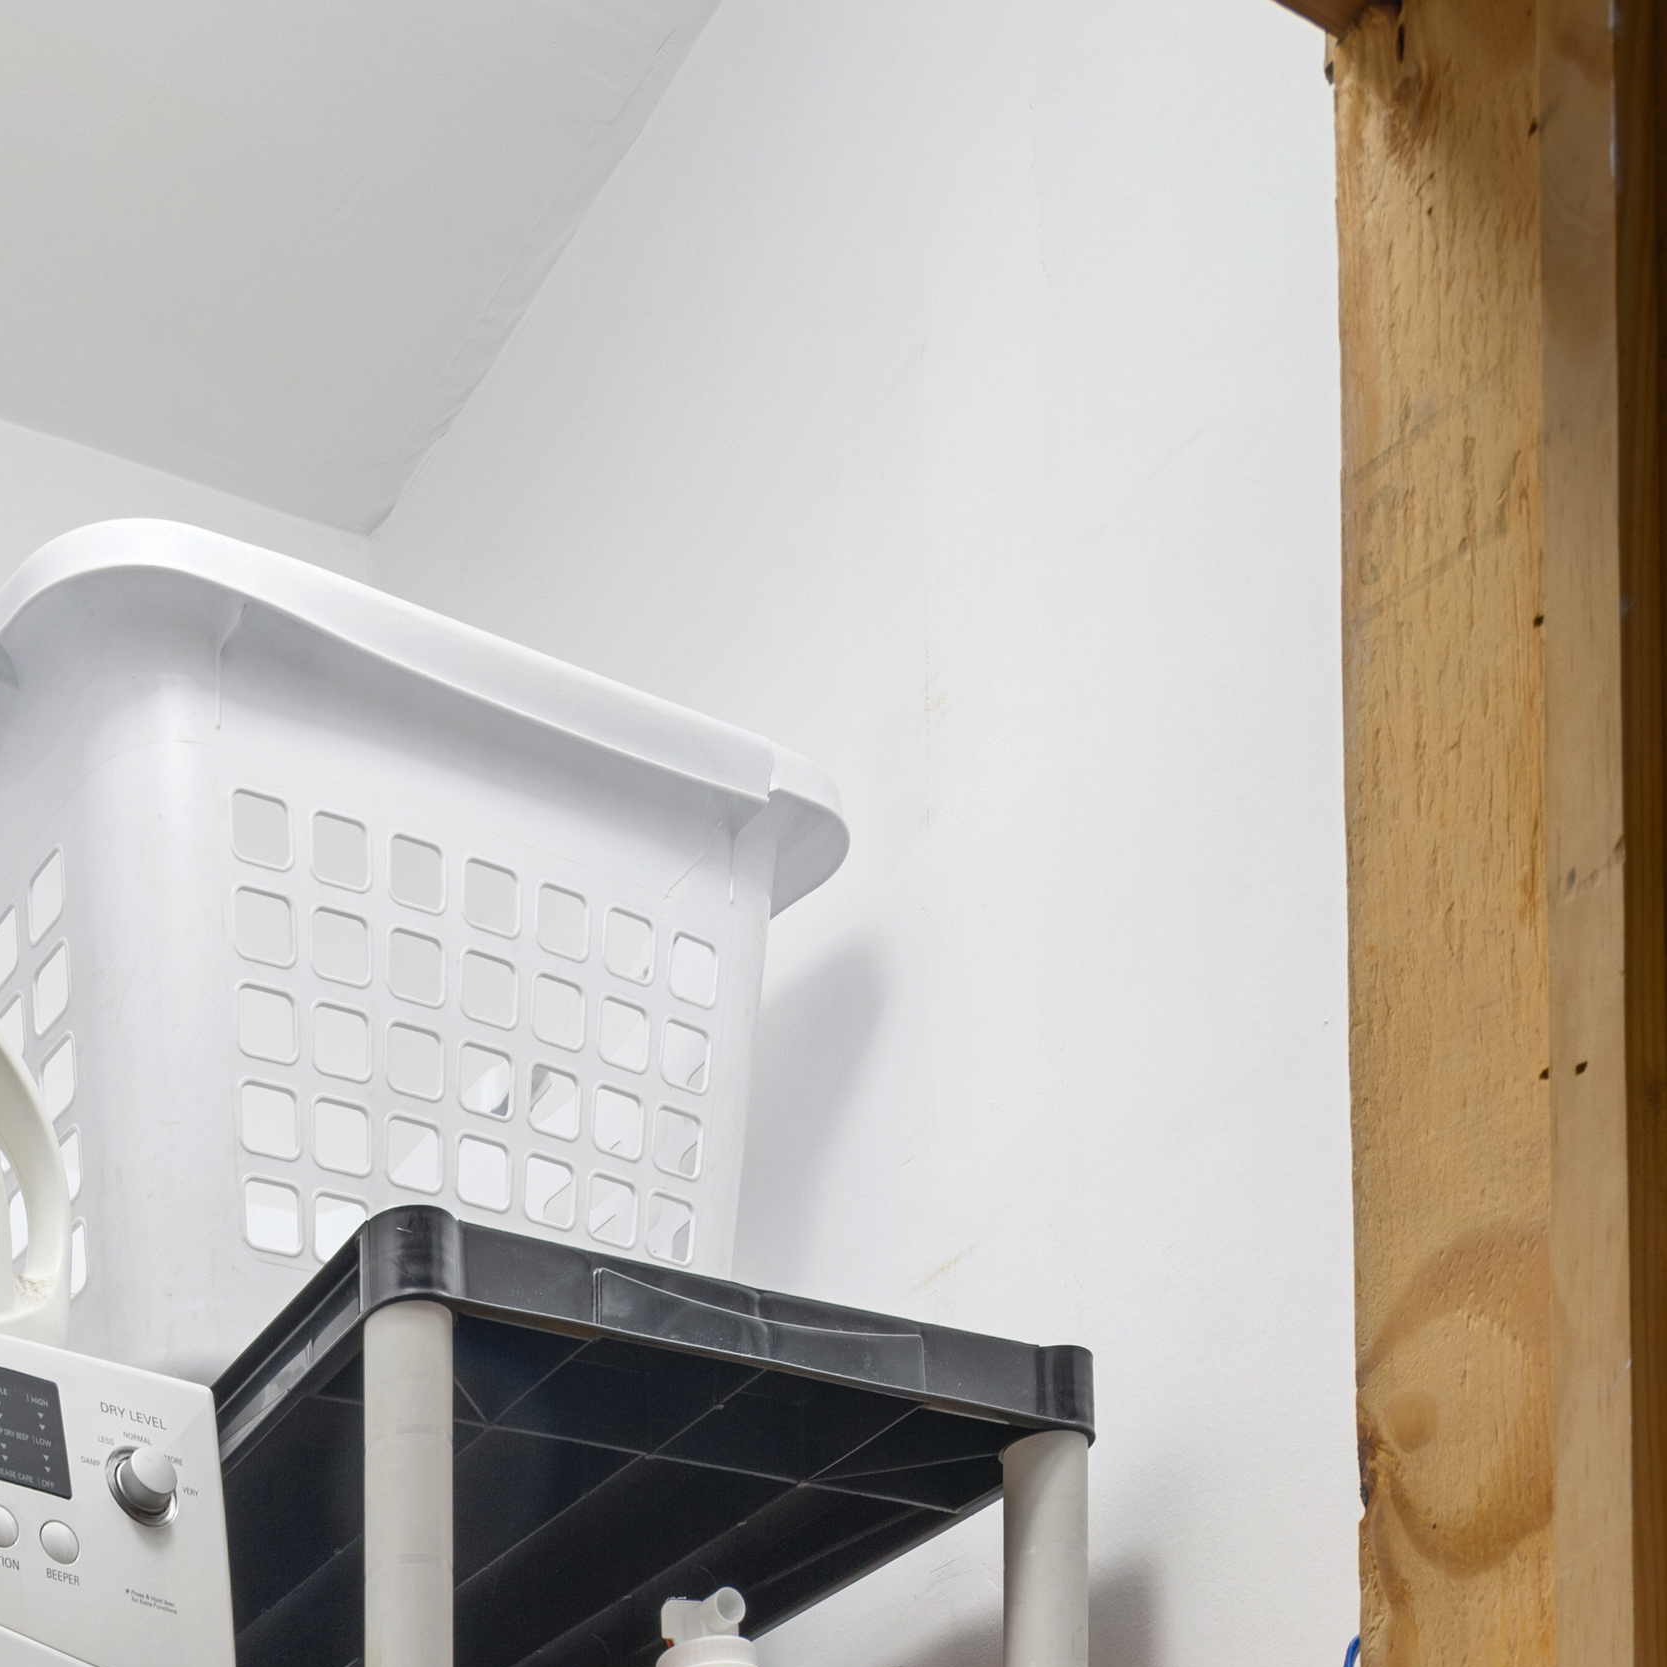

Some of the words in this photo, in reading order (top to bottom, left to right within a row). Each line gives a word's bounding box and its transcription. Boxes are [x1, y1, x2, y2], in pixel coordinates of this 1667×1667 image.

[100, 1402, 126, 1418] DRY
[129, 1409, 167, 1431] LEVEL
[97, 1435, 115, 1446] LESS
[123, 1431, 152, 1446] NORMAL
[80, 1455, 101, 1467] DAMP
[182, 1486, 199, 1497] VERY
[46, 1567, 80, 1587] BEEPER
